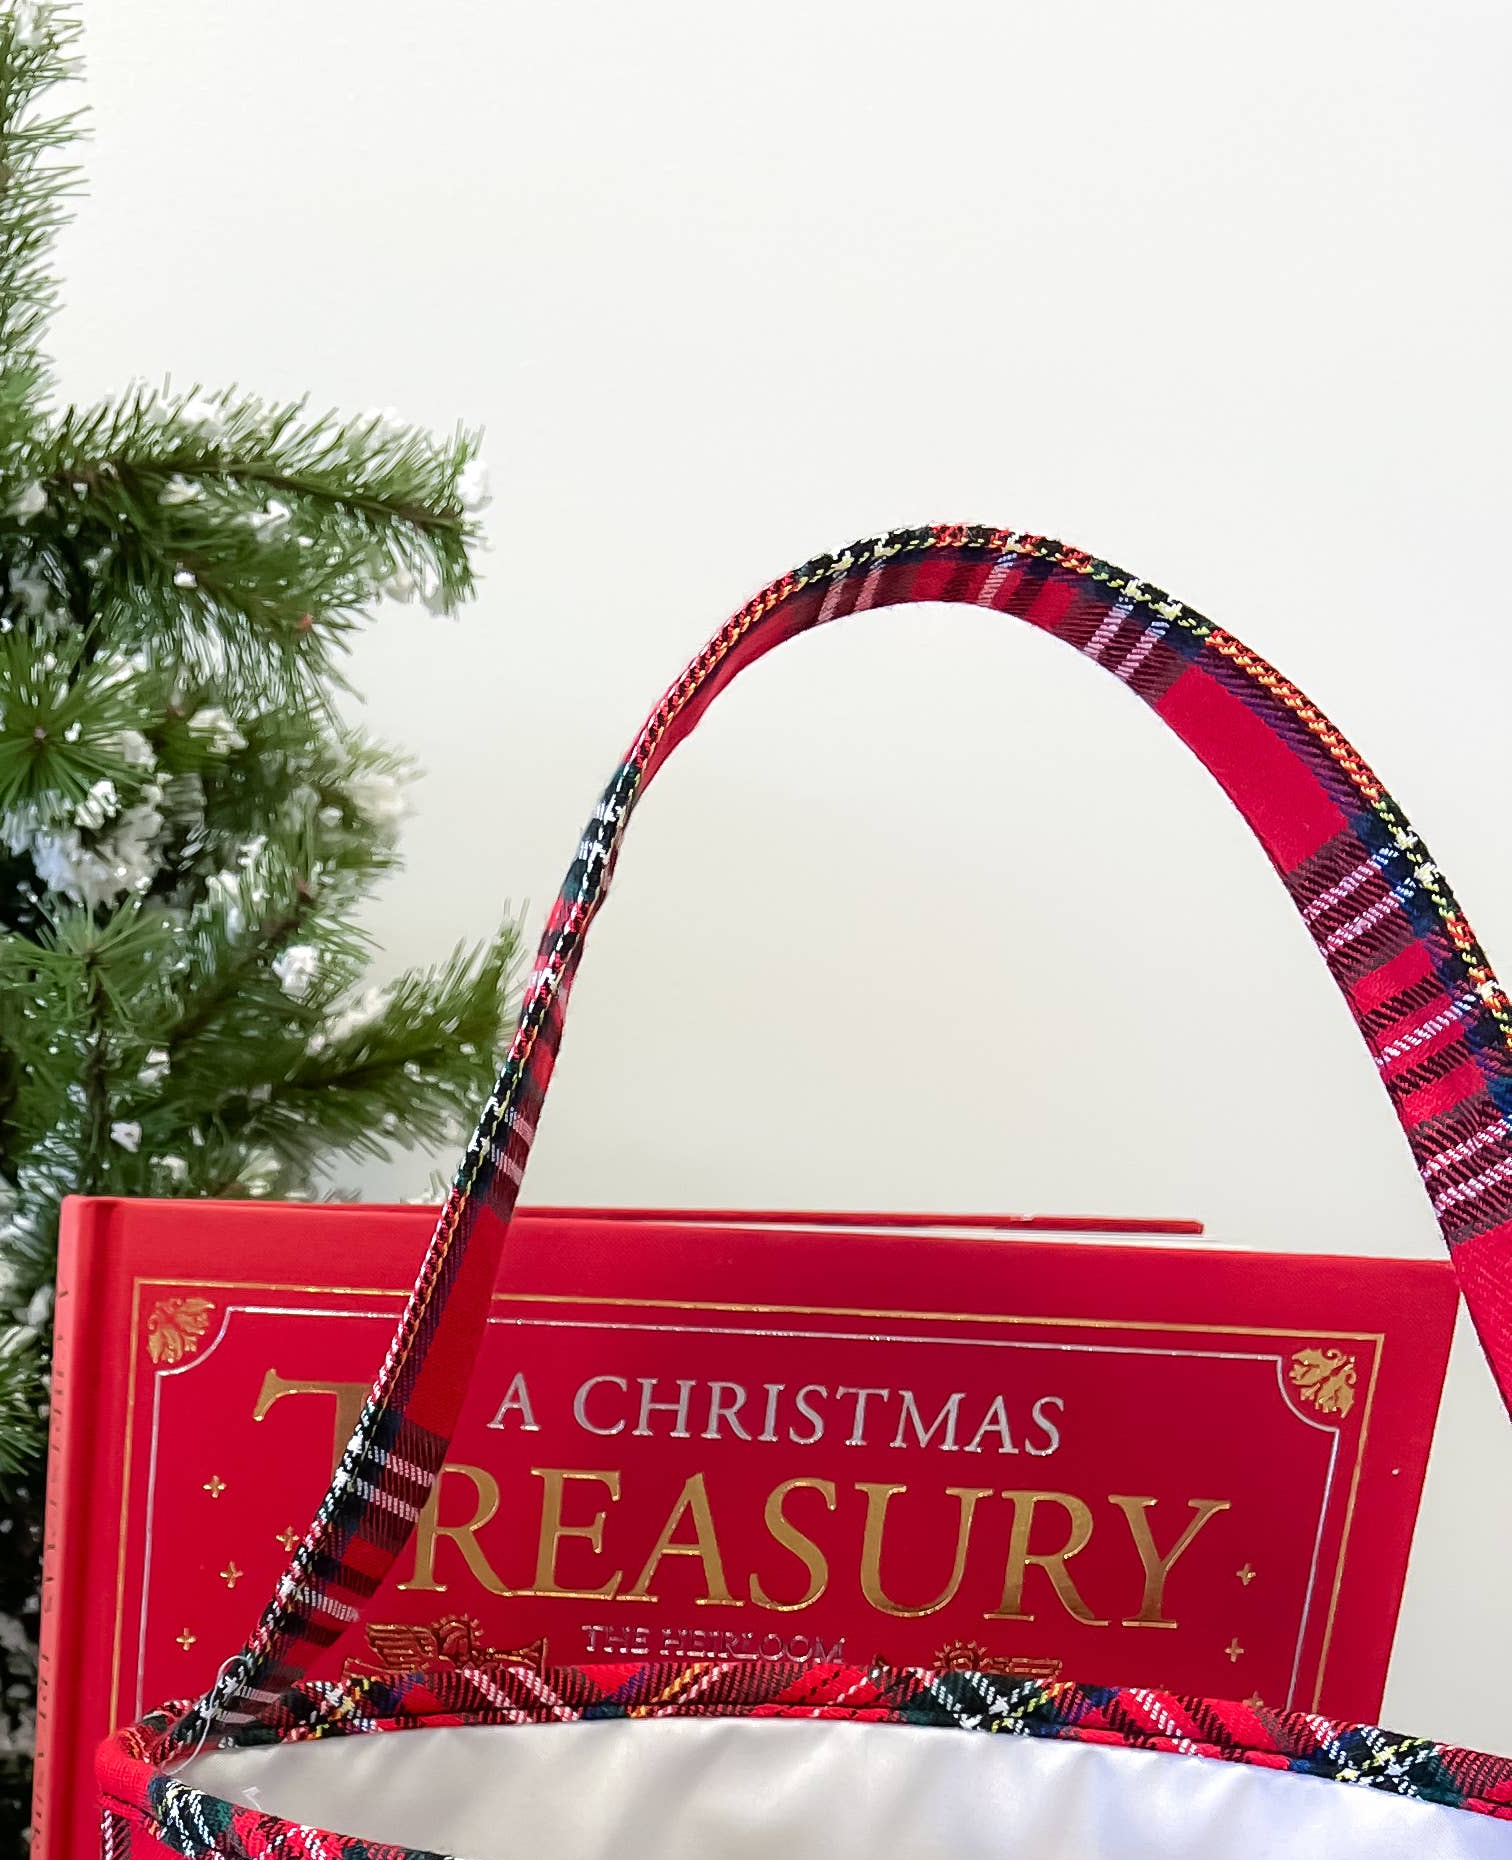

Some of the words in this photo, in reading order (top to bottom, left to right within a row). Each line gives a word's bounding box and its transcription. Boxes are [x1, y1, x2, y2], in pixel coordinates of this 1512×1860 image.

[486, 1371, 541, 1432] A
[572, 1373, 1066, 1458] CHRISTMAS
[581, 1625, 650, 1655] THE
[661, 1628, 846, 1664] HEIRLOOM
